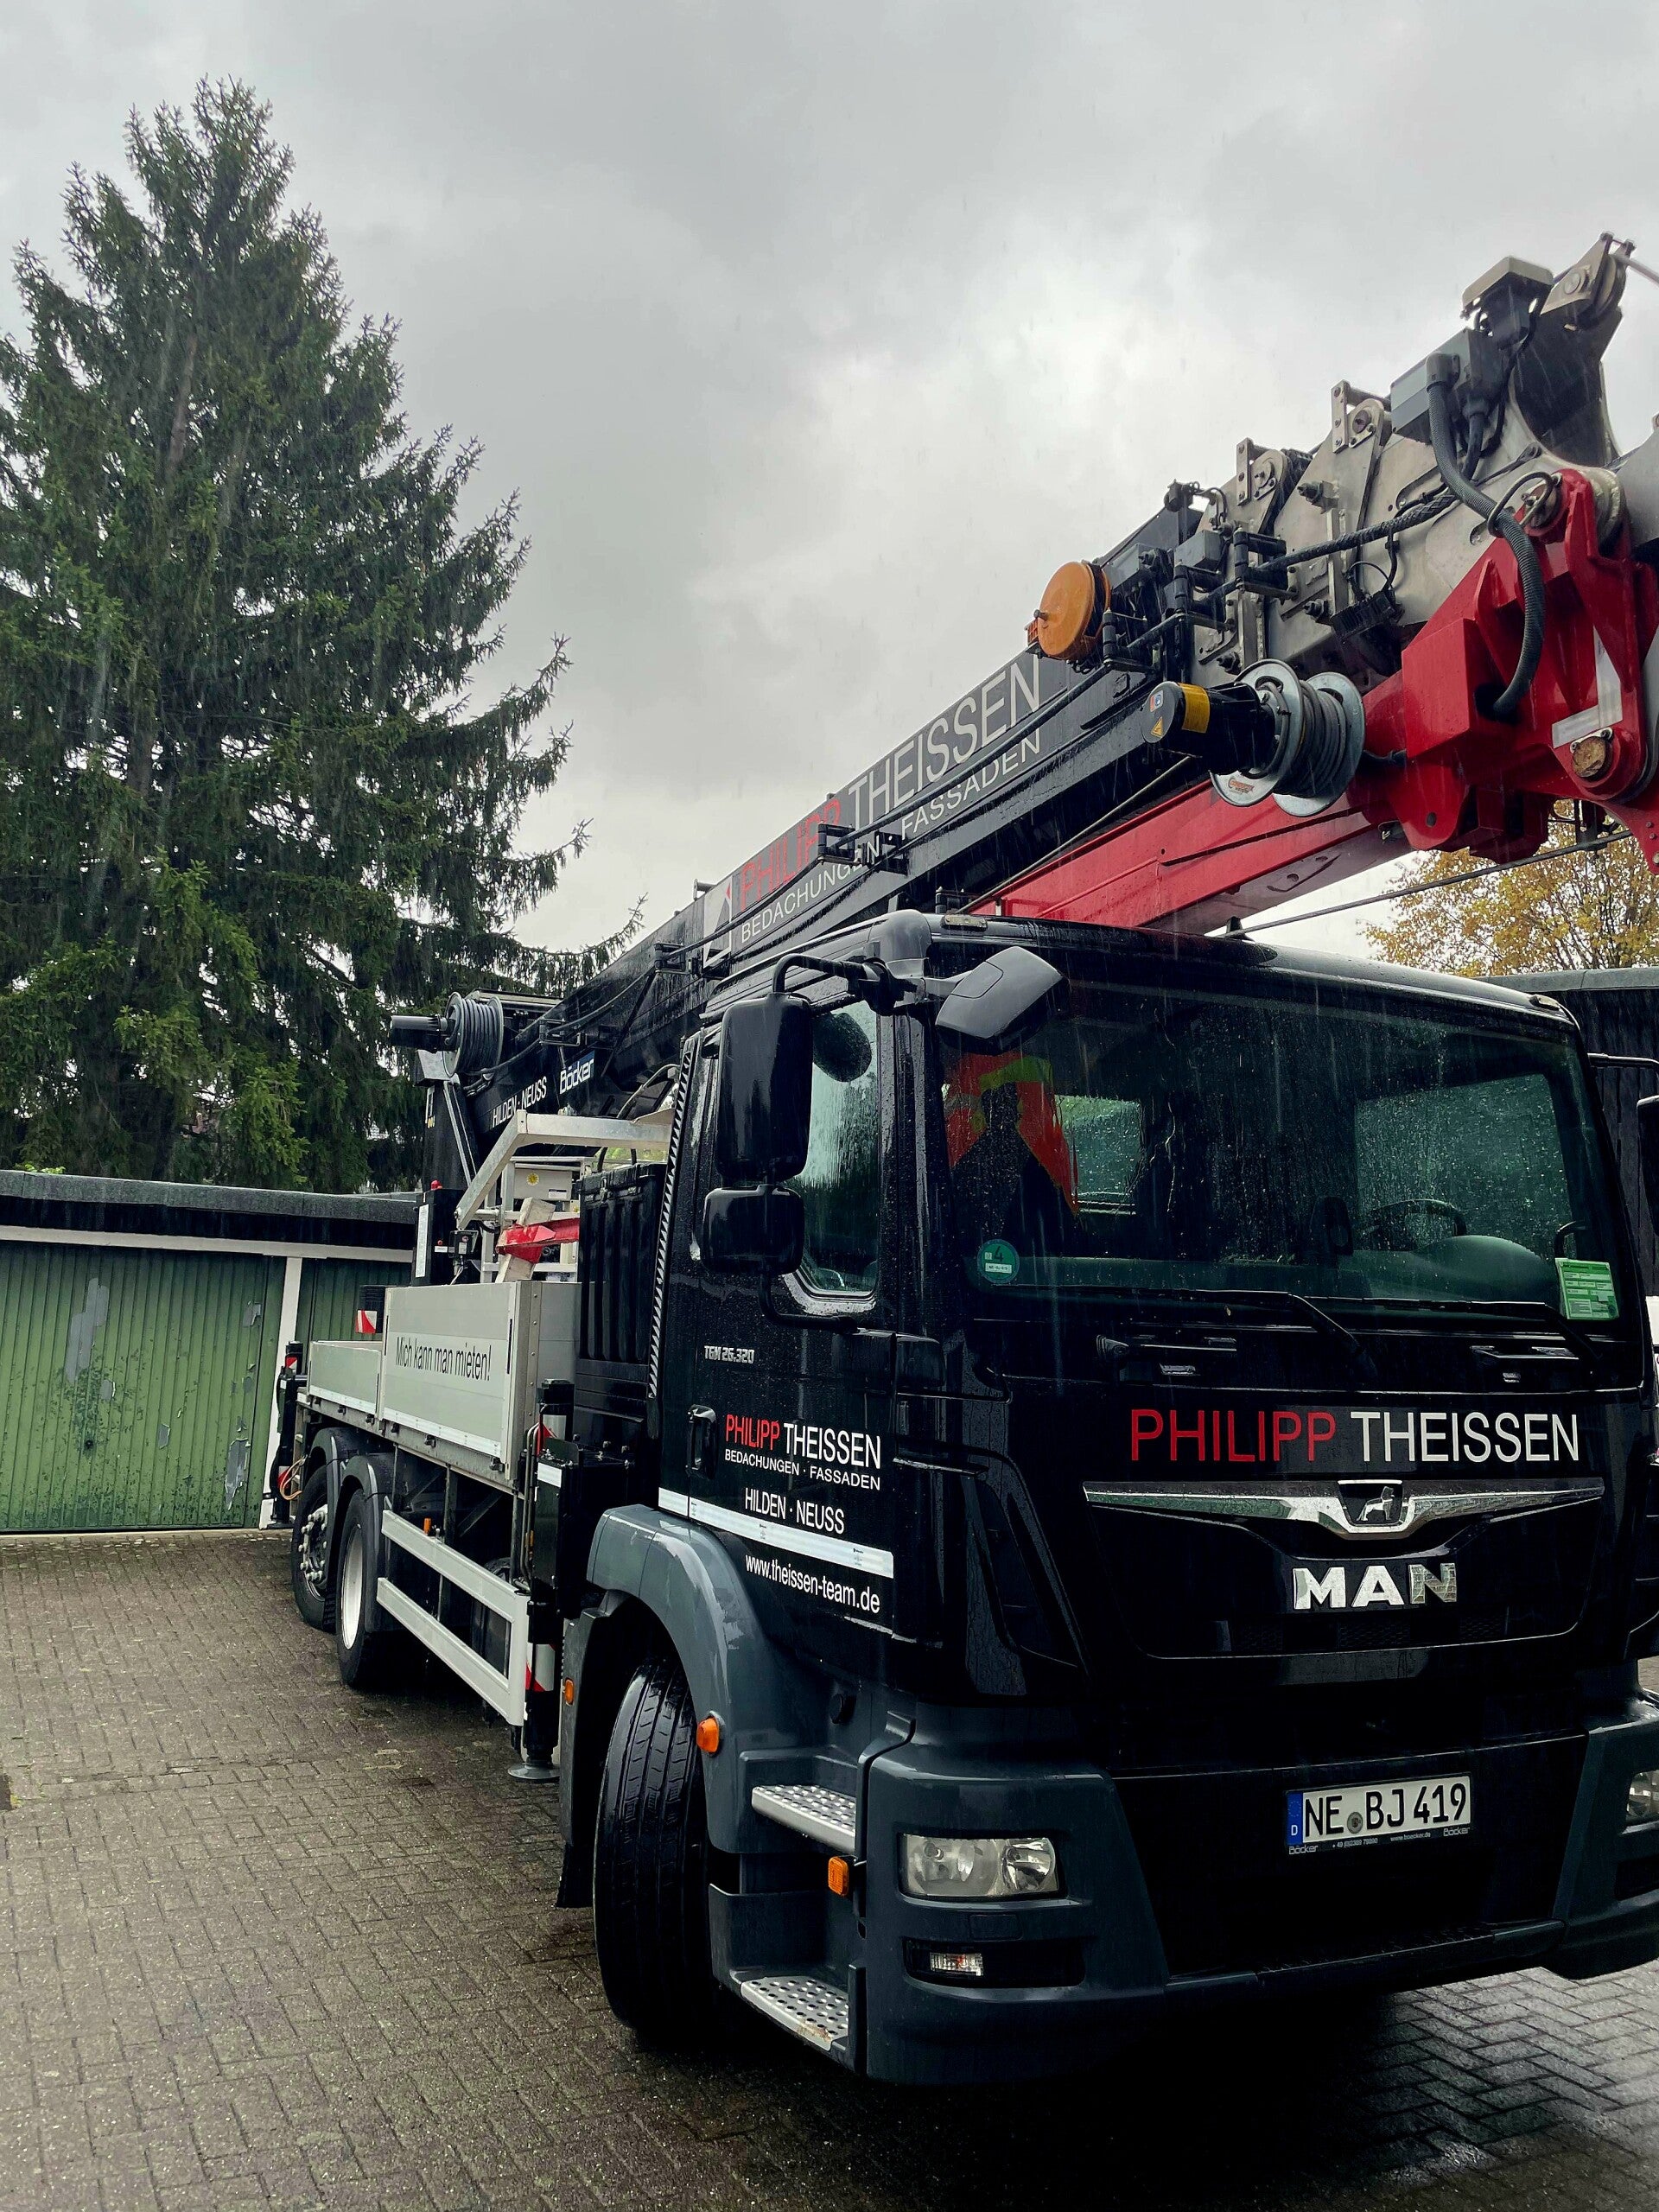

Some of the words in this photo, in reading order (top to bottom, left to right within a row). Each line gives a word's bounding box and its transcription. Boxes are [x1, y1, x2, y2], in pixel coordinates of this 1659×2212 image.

[741, 798, 842, 913] PHILIPP
[848, 654, 1039, 830] THEISSEN
[901, 728, 1040, 841] FASSADEN
[559, 1058, 594, 1095] Böcker
[492, 1095, 517, 1128] HILDEN
[521, 1076, 547, 1109] NEUSS
[995, 1245, 1004, 1262] 4
[396, 1336, 413, 1368] Mich
[413, 1338, 432, 1371] kann
[434, 1348, 453, 1375] man
[454, 1342, 492, 1381] mieten!
[726, 1414, 780, 1451] PHILIPP
[783, 1422, 881, 1469] THEISSEN
[1130, 1408, 1337, 1462] PHILIPP
[1350, 1411, 1580, 1463] THEISSEN
[724, 1448, 799, 1476] BEDACHUNGEN
[809, 1465, 880, 1491] FASSADEN
[744, 1487, 786, 1520] HILDEN
[796, 1499, 844, 1535] NEUSS
[745, 1554, 880, 1614] www.theissen-team.de
[1293, 1562, 1458, 1610] MAN
[1291, 1824, 1299, 1836] D
[1305, 1795, 1344, 1838] NE
[1366, 1788, 1405, 1830] BJ
[1413, 1783, 1466, 1824] 419
